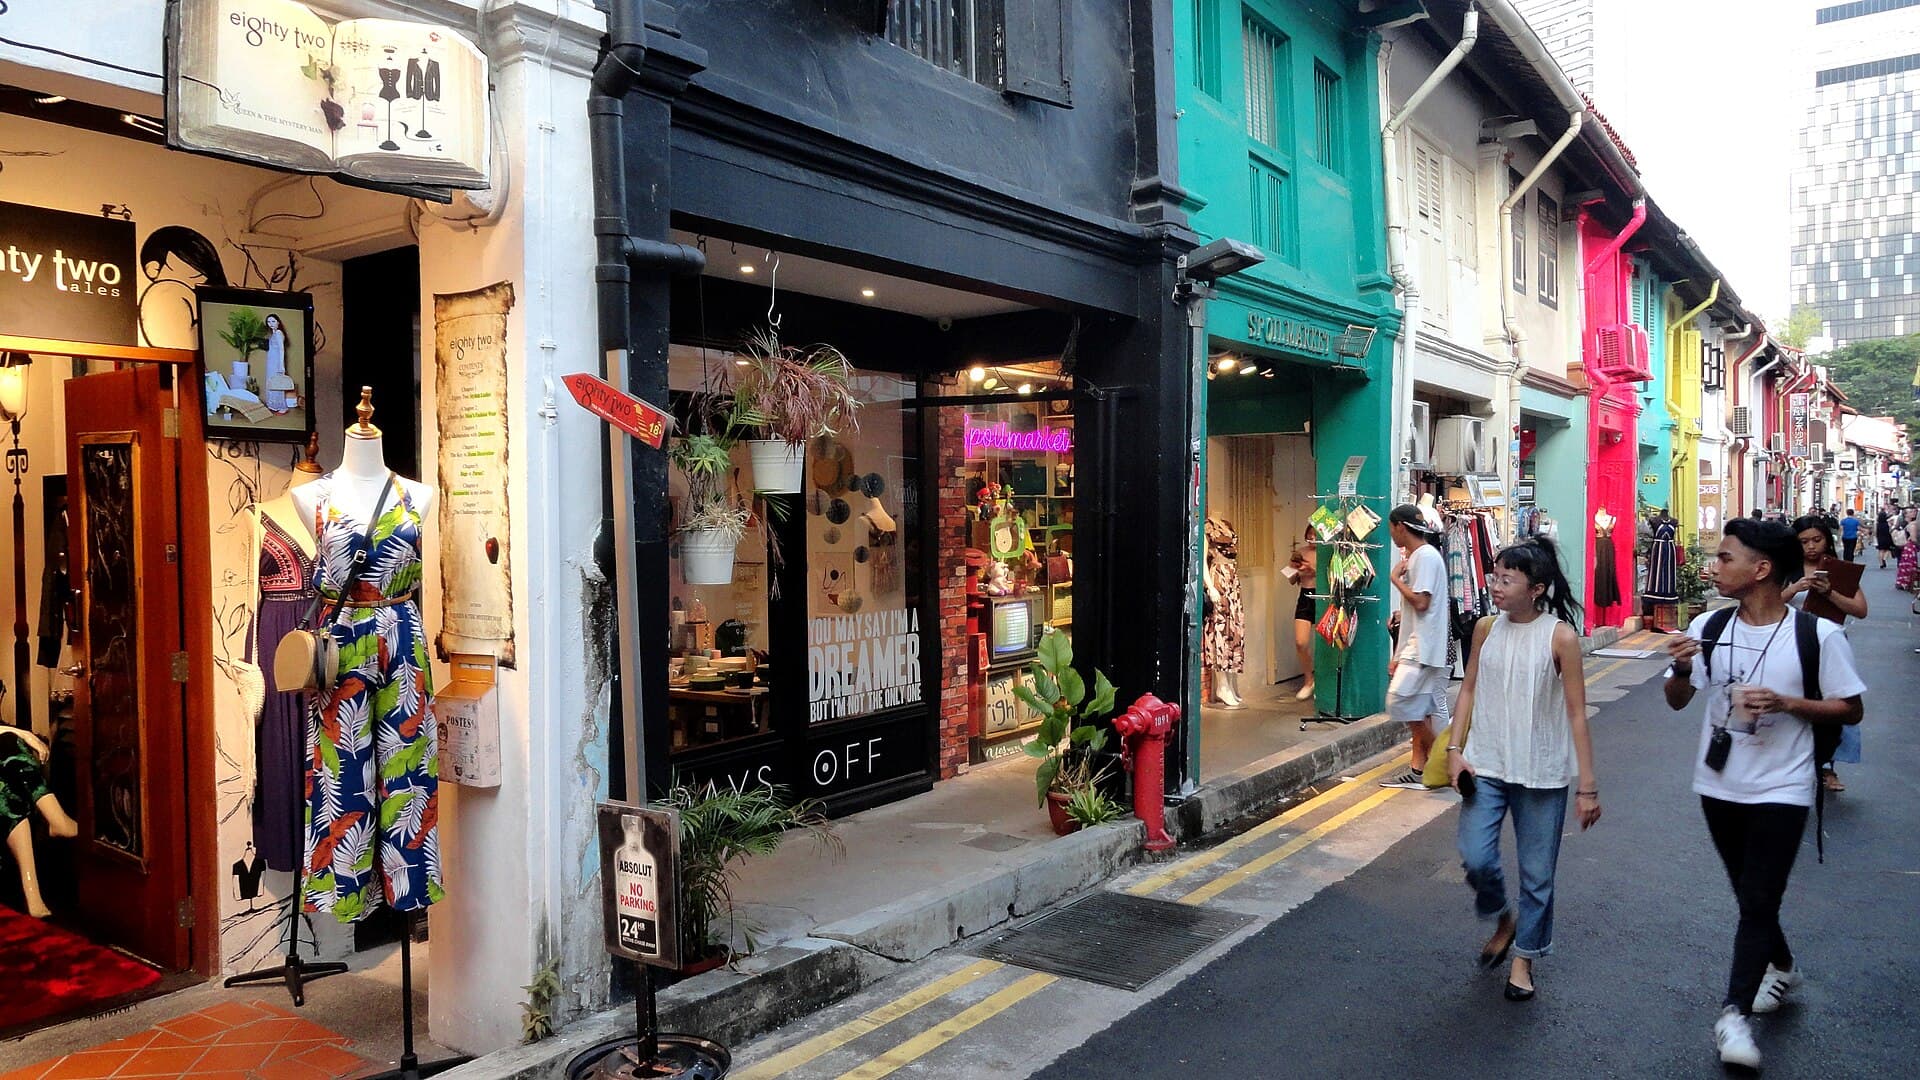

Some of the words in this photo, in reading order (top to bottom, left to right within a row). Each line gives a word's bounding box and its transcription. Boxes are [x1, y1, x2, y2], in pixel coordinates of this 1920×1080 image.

[230, 12, 288, 46] eighty
[294, 26, 326, 49] two
[279, 119, 307, 130] MYSTERY
[53, 249, 121, 292] two
[478, 334, 492, 350] two
[808, 618, 832, 646] YOU
[836, 613, 862, 642] MAY
[864, 610, 887, 638] SAY
[890, 608, 908, 634] I'M
[911, 608, 920, 632] A
[808, 632, 921, 702] DREAMER
[810, 700, 828, 723] BUT
[831, 696, 846, 719] I'M
[847, 694, 865, 716] NOT
[867, 688, 884, 710] THE
[884, 686, 906, 708] ONLY
[906, 682, 922, 703] ONE
[446, 715, 472, 729] POSTES
[1154, 714, 1169, 727] 1091
[814, 738, 882, 786] OFF
[619, 860, 652, 878] ABSOLUT
[630, 882, 644, 897] NO
[620, 894, 655, 912] PARKING
